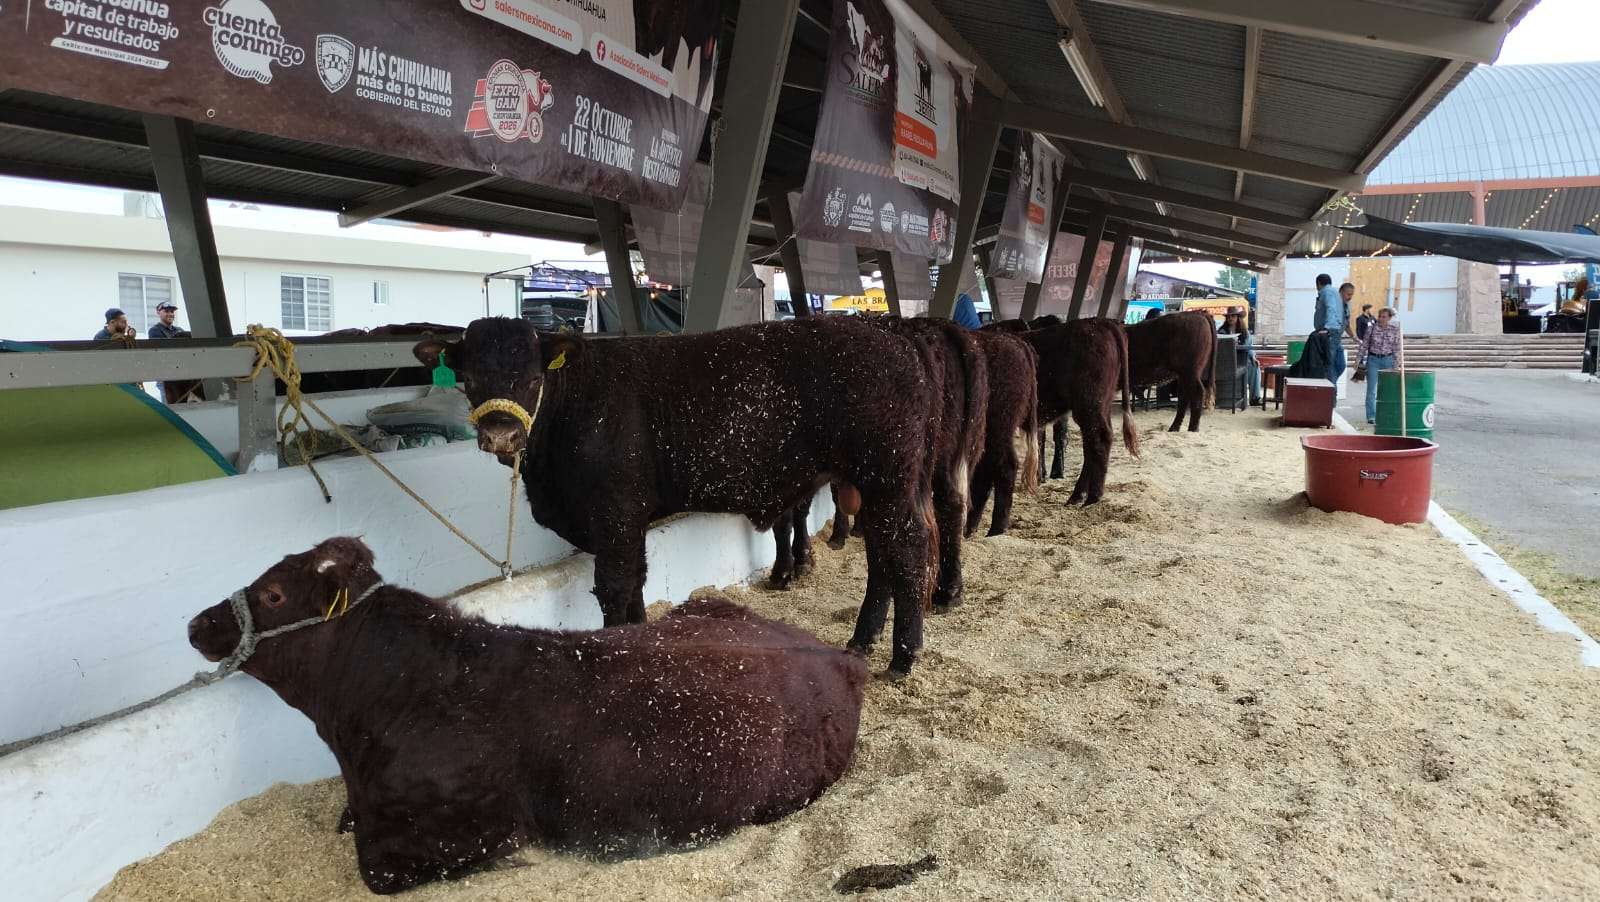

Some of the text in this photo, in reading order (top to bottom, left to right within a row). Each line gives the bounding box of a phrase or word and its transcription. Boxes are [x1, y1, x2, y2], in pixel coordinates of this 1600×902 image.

[45, 0, 179, 40] capital de trabajo
[62, 19, 160, 52] y resultados
[204, 8, 284, 43] cuenta
[217, 30, 304, 65] conmigo
[358, 46, 386, 77] MÁS
[388, 55, 452, 94] CHIHUAHUA
[356, 73, 453, 107] más de lo bueno
[356, 88, 452, 118] GOBIERNO DEL ESTADO
[493, 85, 520, 97] EXPO
[496, 97, 519, 109] GAN
[574, 95, 591, 130] 22
[592, 102, 633, 144] OCTUBRE
[574, 128, 588, 158] DE
[588, 130, 636, 172] NOVIEMBRE
